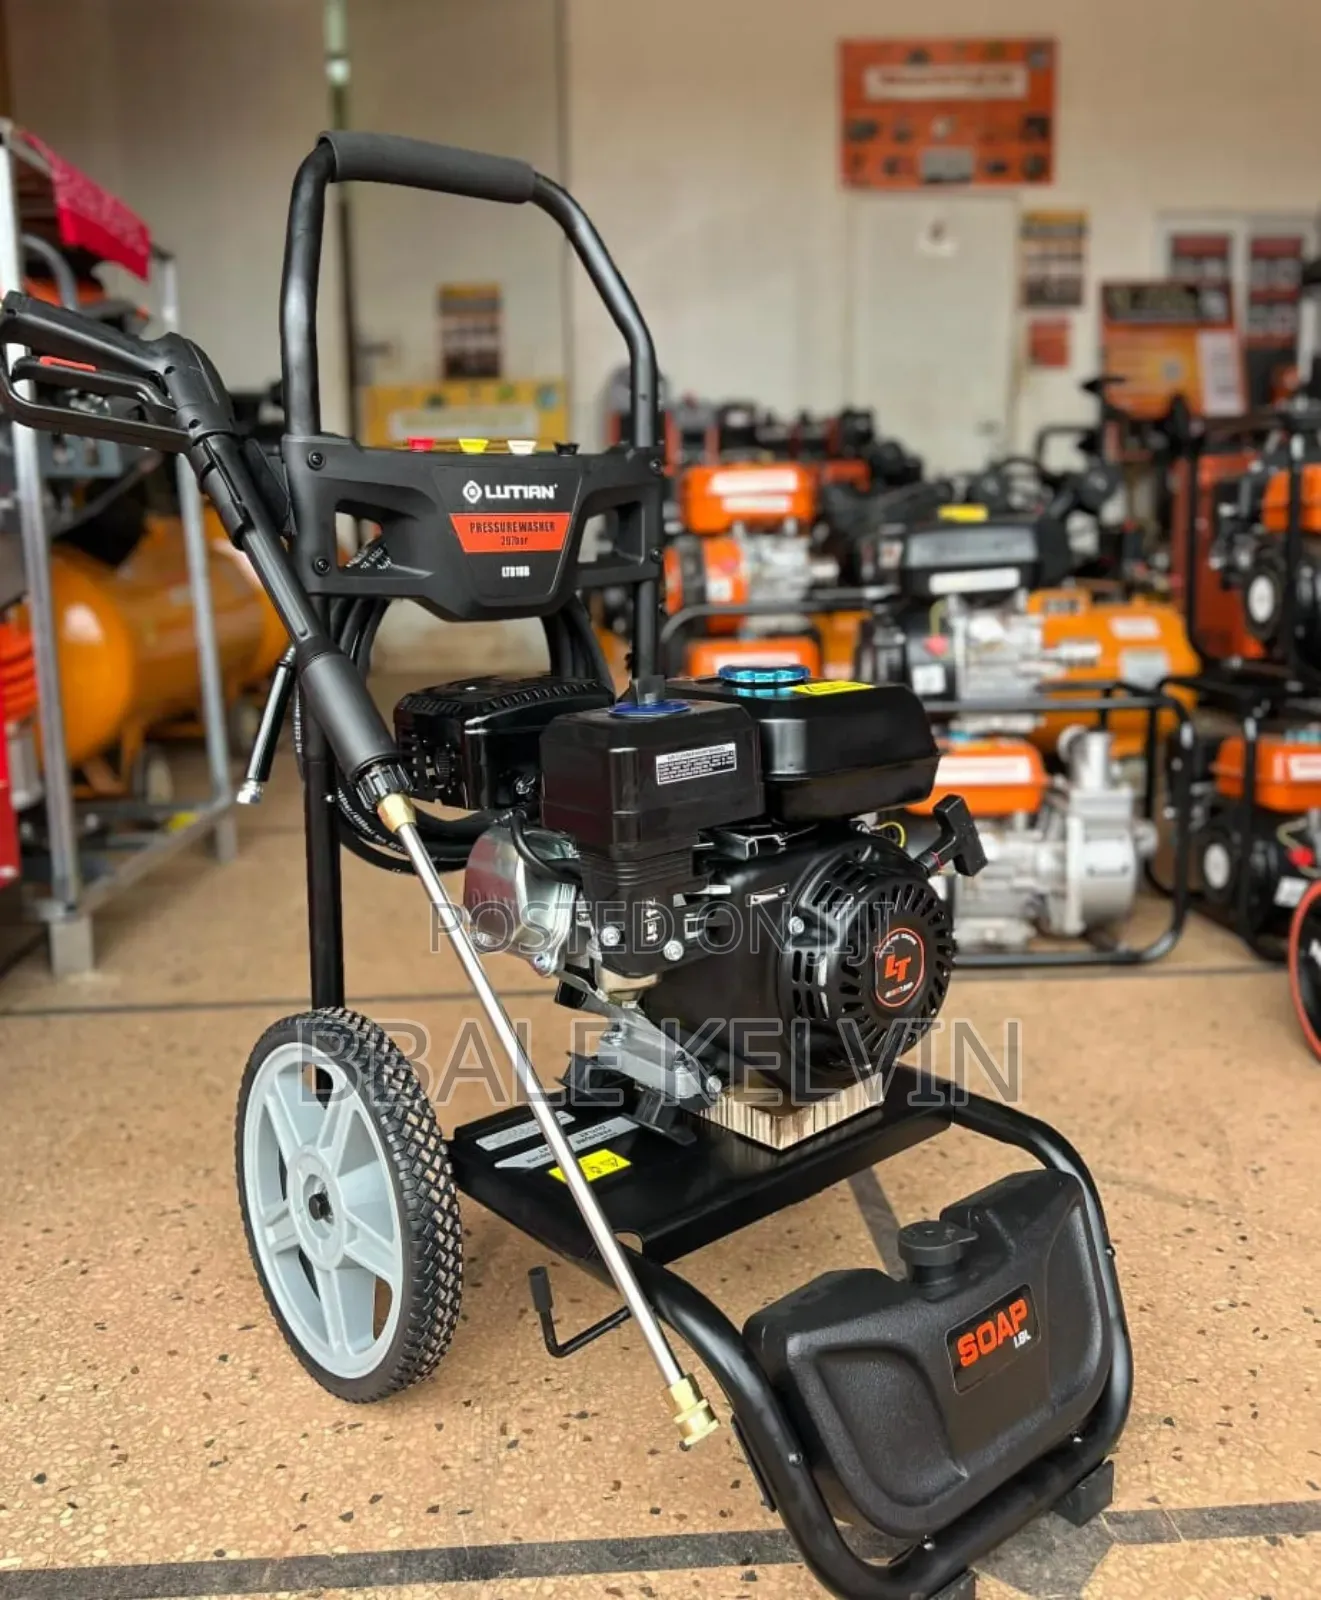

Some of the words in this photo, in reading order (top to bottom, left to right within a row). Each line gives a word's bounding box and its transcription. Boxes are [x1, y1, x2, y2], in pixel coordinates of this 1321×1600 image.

[484, 484, 556, 500] LUTIAN
[469, 521, 556, 534] PRESSUREWASHER
[957, 1298, 1028, 1368] SOAP
